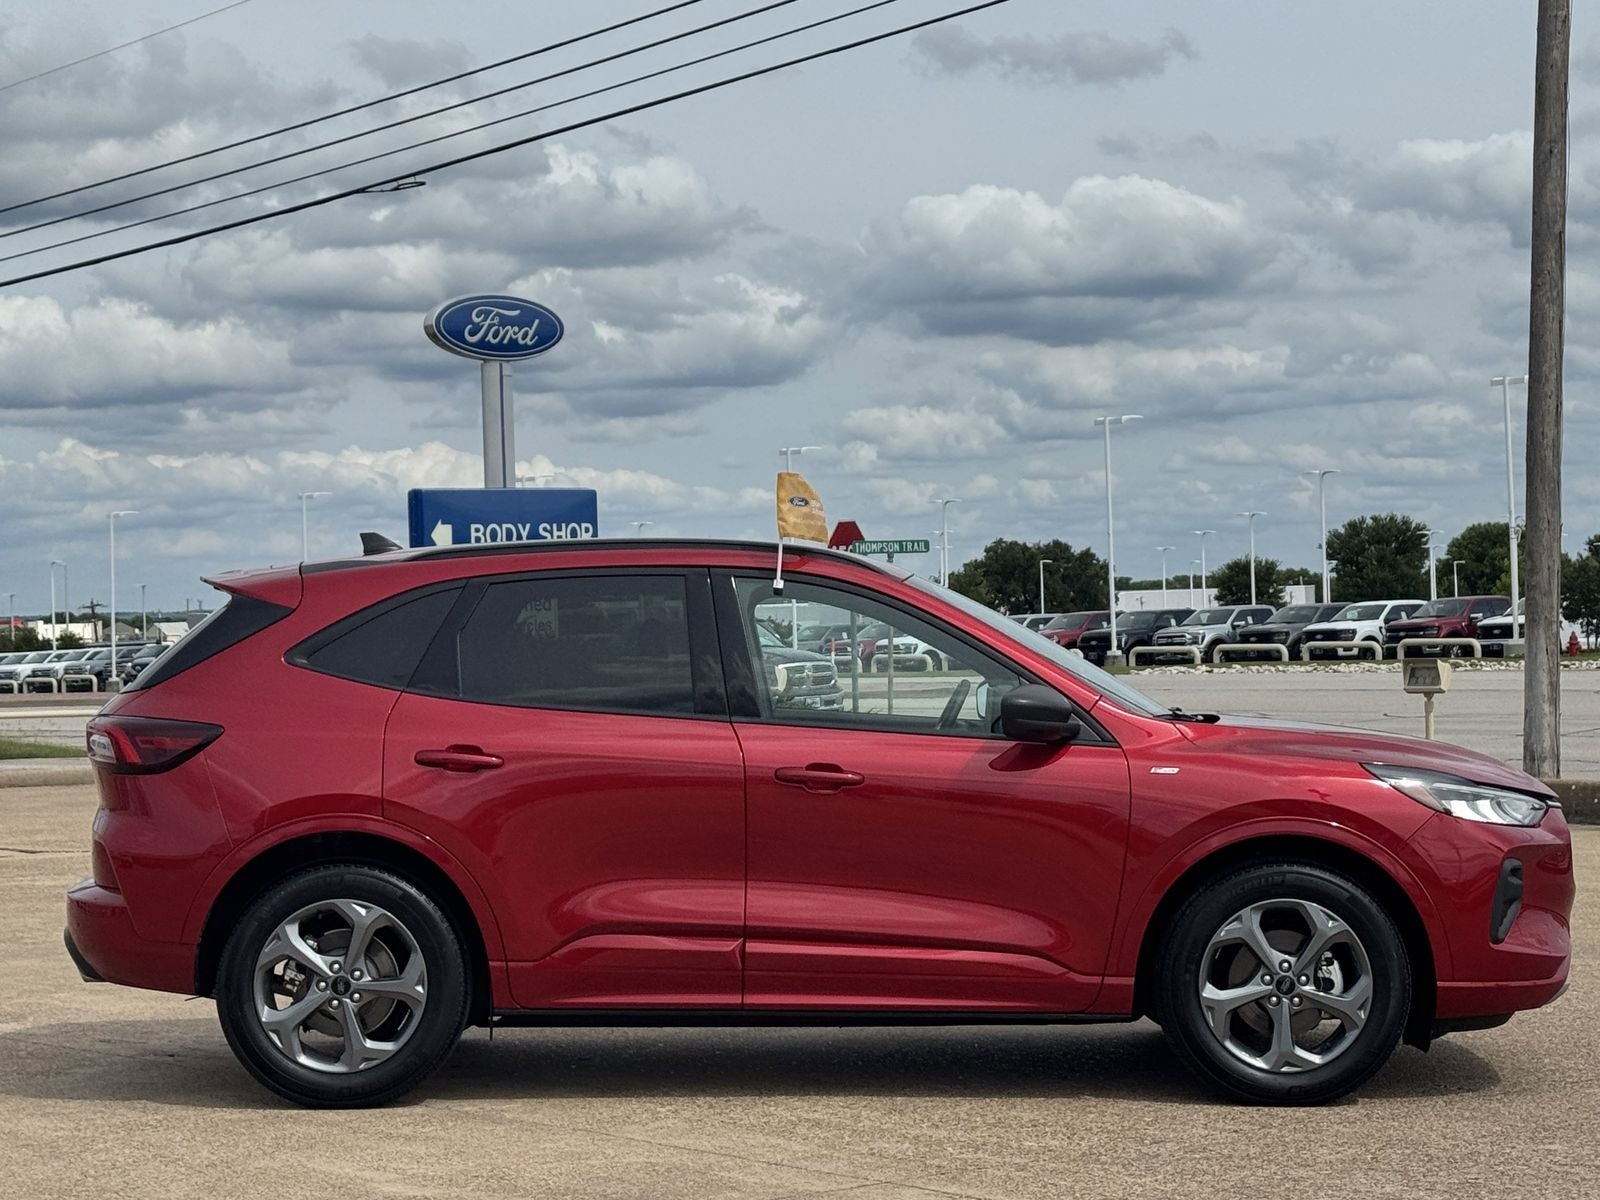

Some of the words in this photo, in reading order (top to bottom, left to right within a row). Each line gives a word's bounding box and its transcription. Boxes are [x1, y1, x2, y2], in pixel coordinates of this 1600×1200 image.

[464, 306, 540, 345] Ford
[470, 523, 531, 544] BODY
[539, 522, 593, 540] SHOP
[855, 542, 900, 553] THOMPSON
[902, 541, 928, 552] TRAIL
